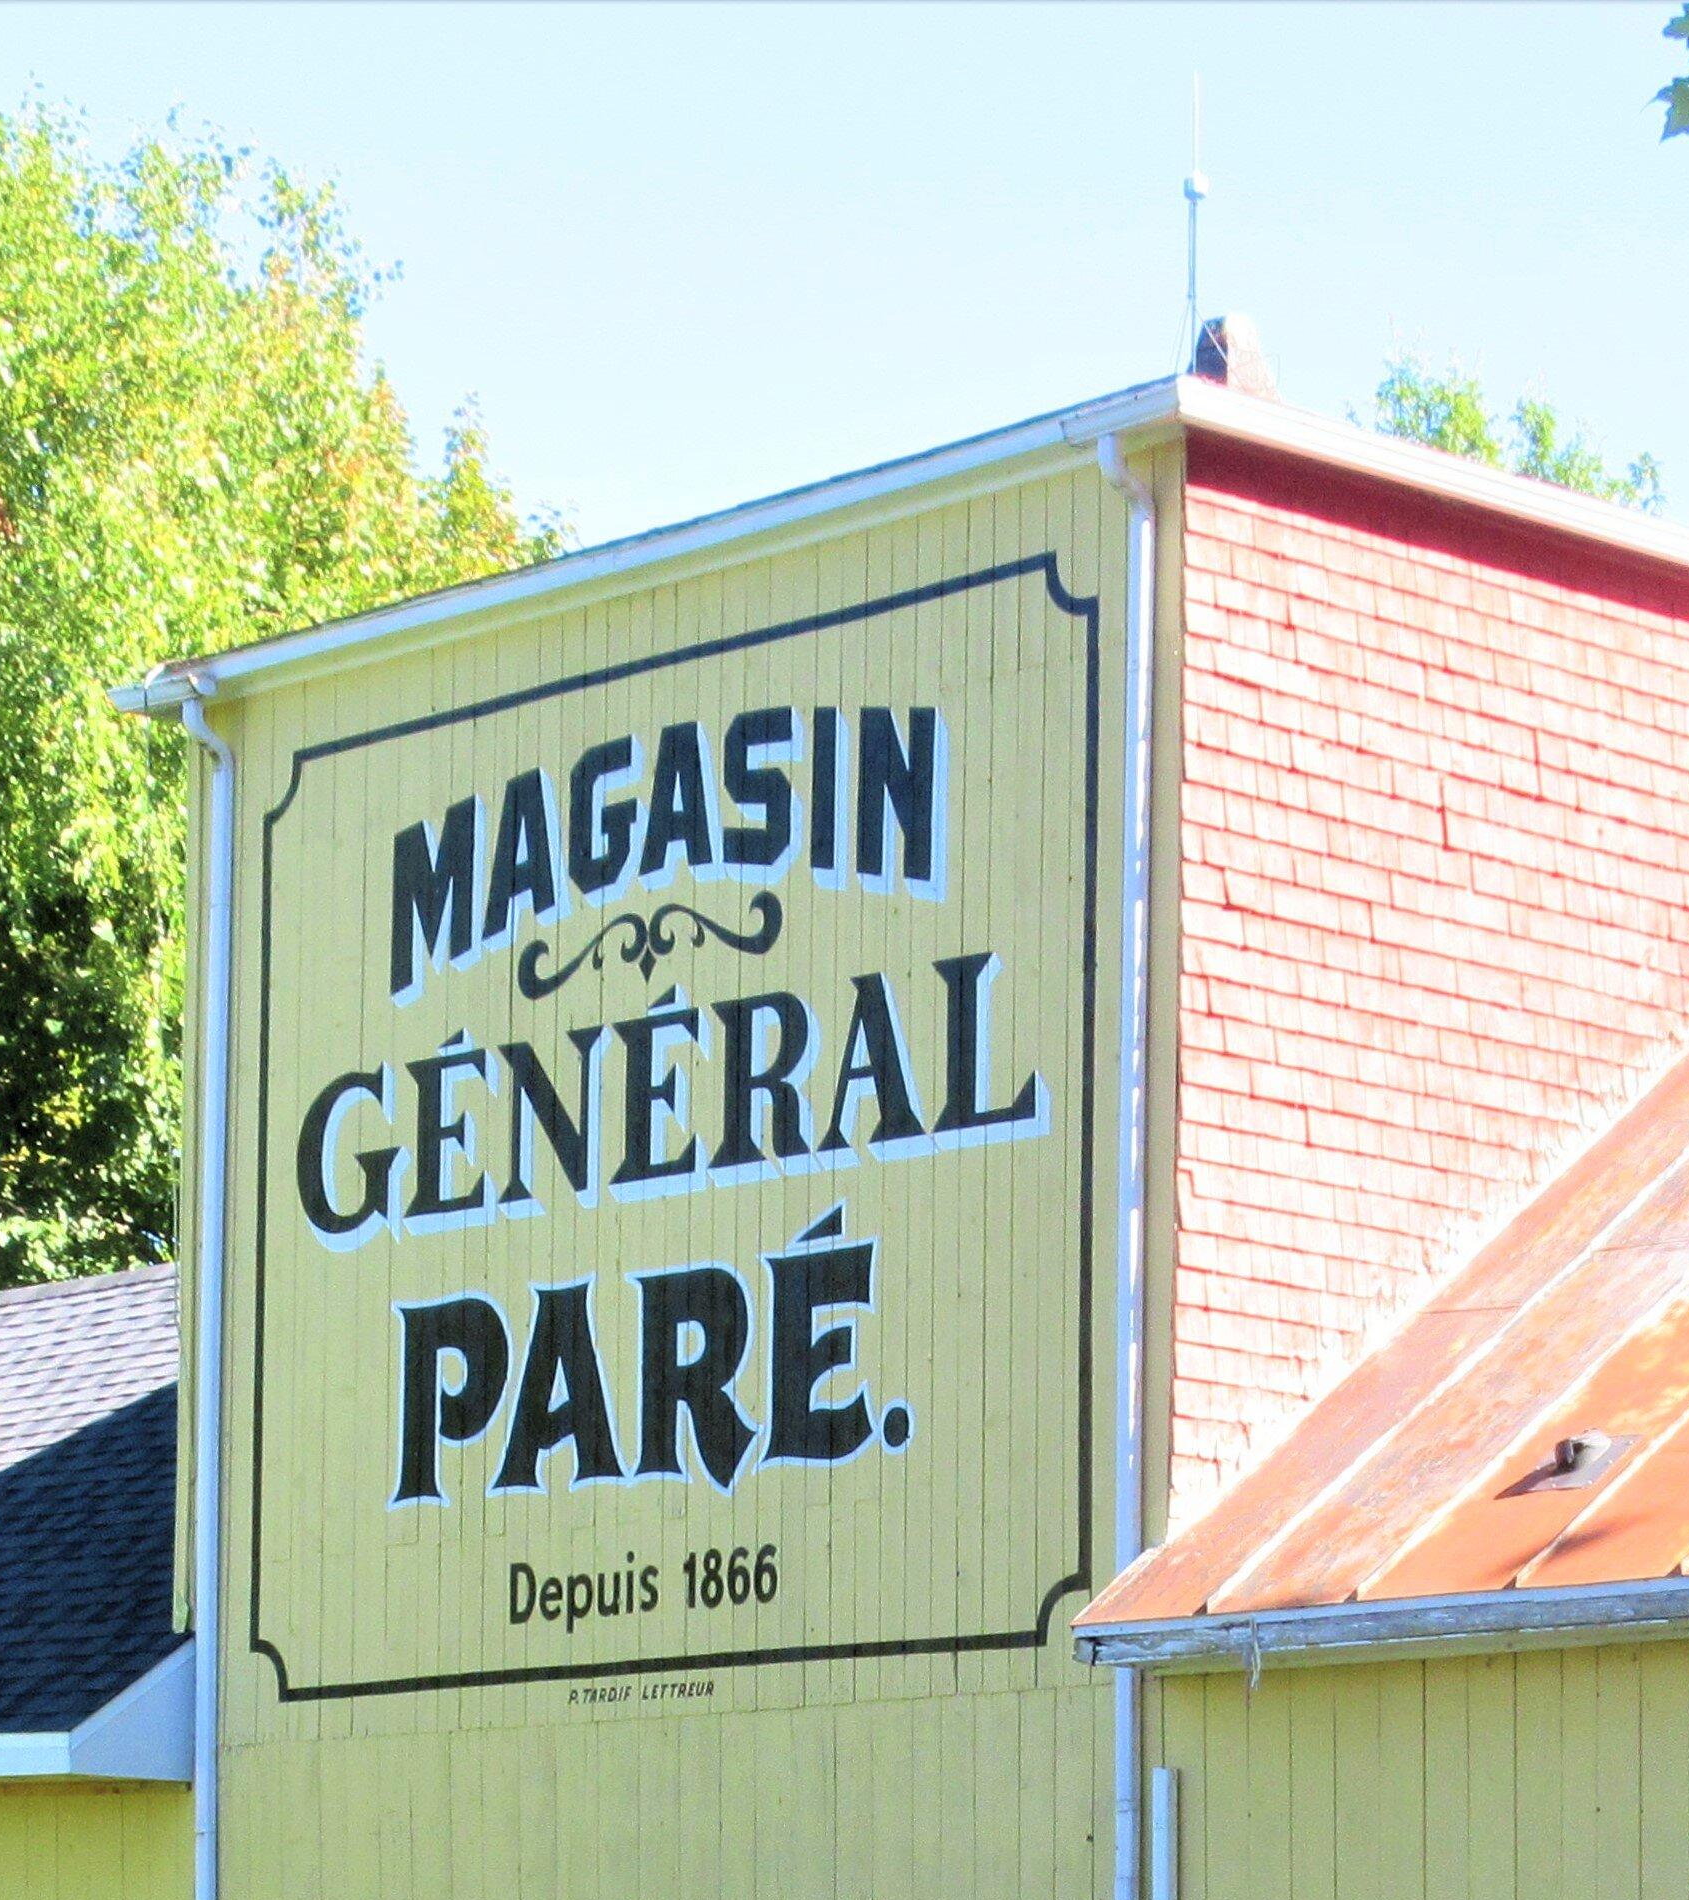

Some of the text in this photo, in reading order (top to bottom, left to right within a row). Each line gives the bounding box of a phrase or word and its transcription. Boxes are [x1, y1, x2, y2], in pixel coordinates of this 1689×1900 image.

[389, 703, 945, 1006] MAGASIN
[295, 950, 1051, 1250] GÉNÉRAL
[389, 1201, 913, 1508] PARÉ.
[509, 1543, 779, 1634] Depuis 1866
[641, 1681, 715, 1701] LETTREUR
